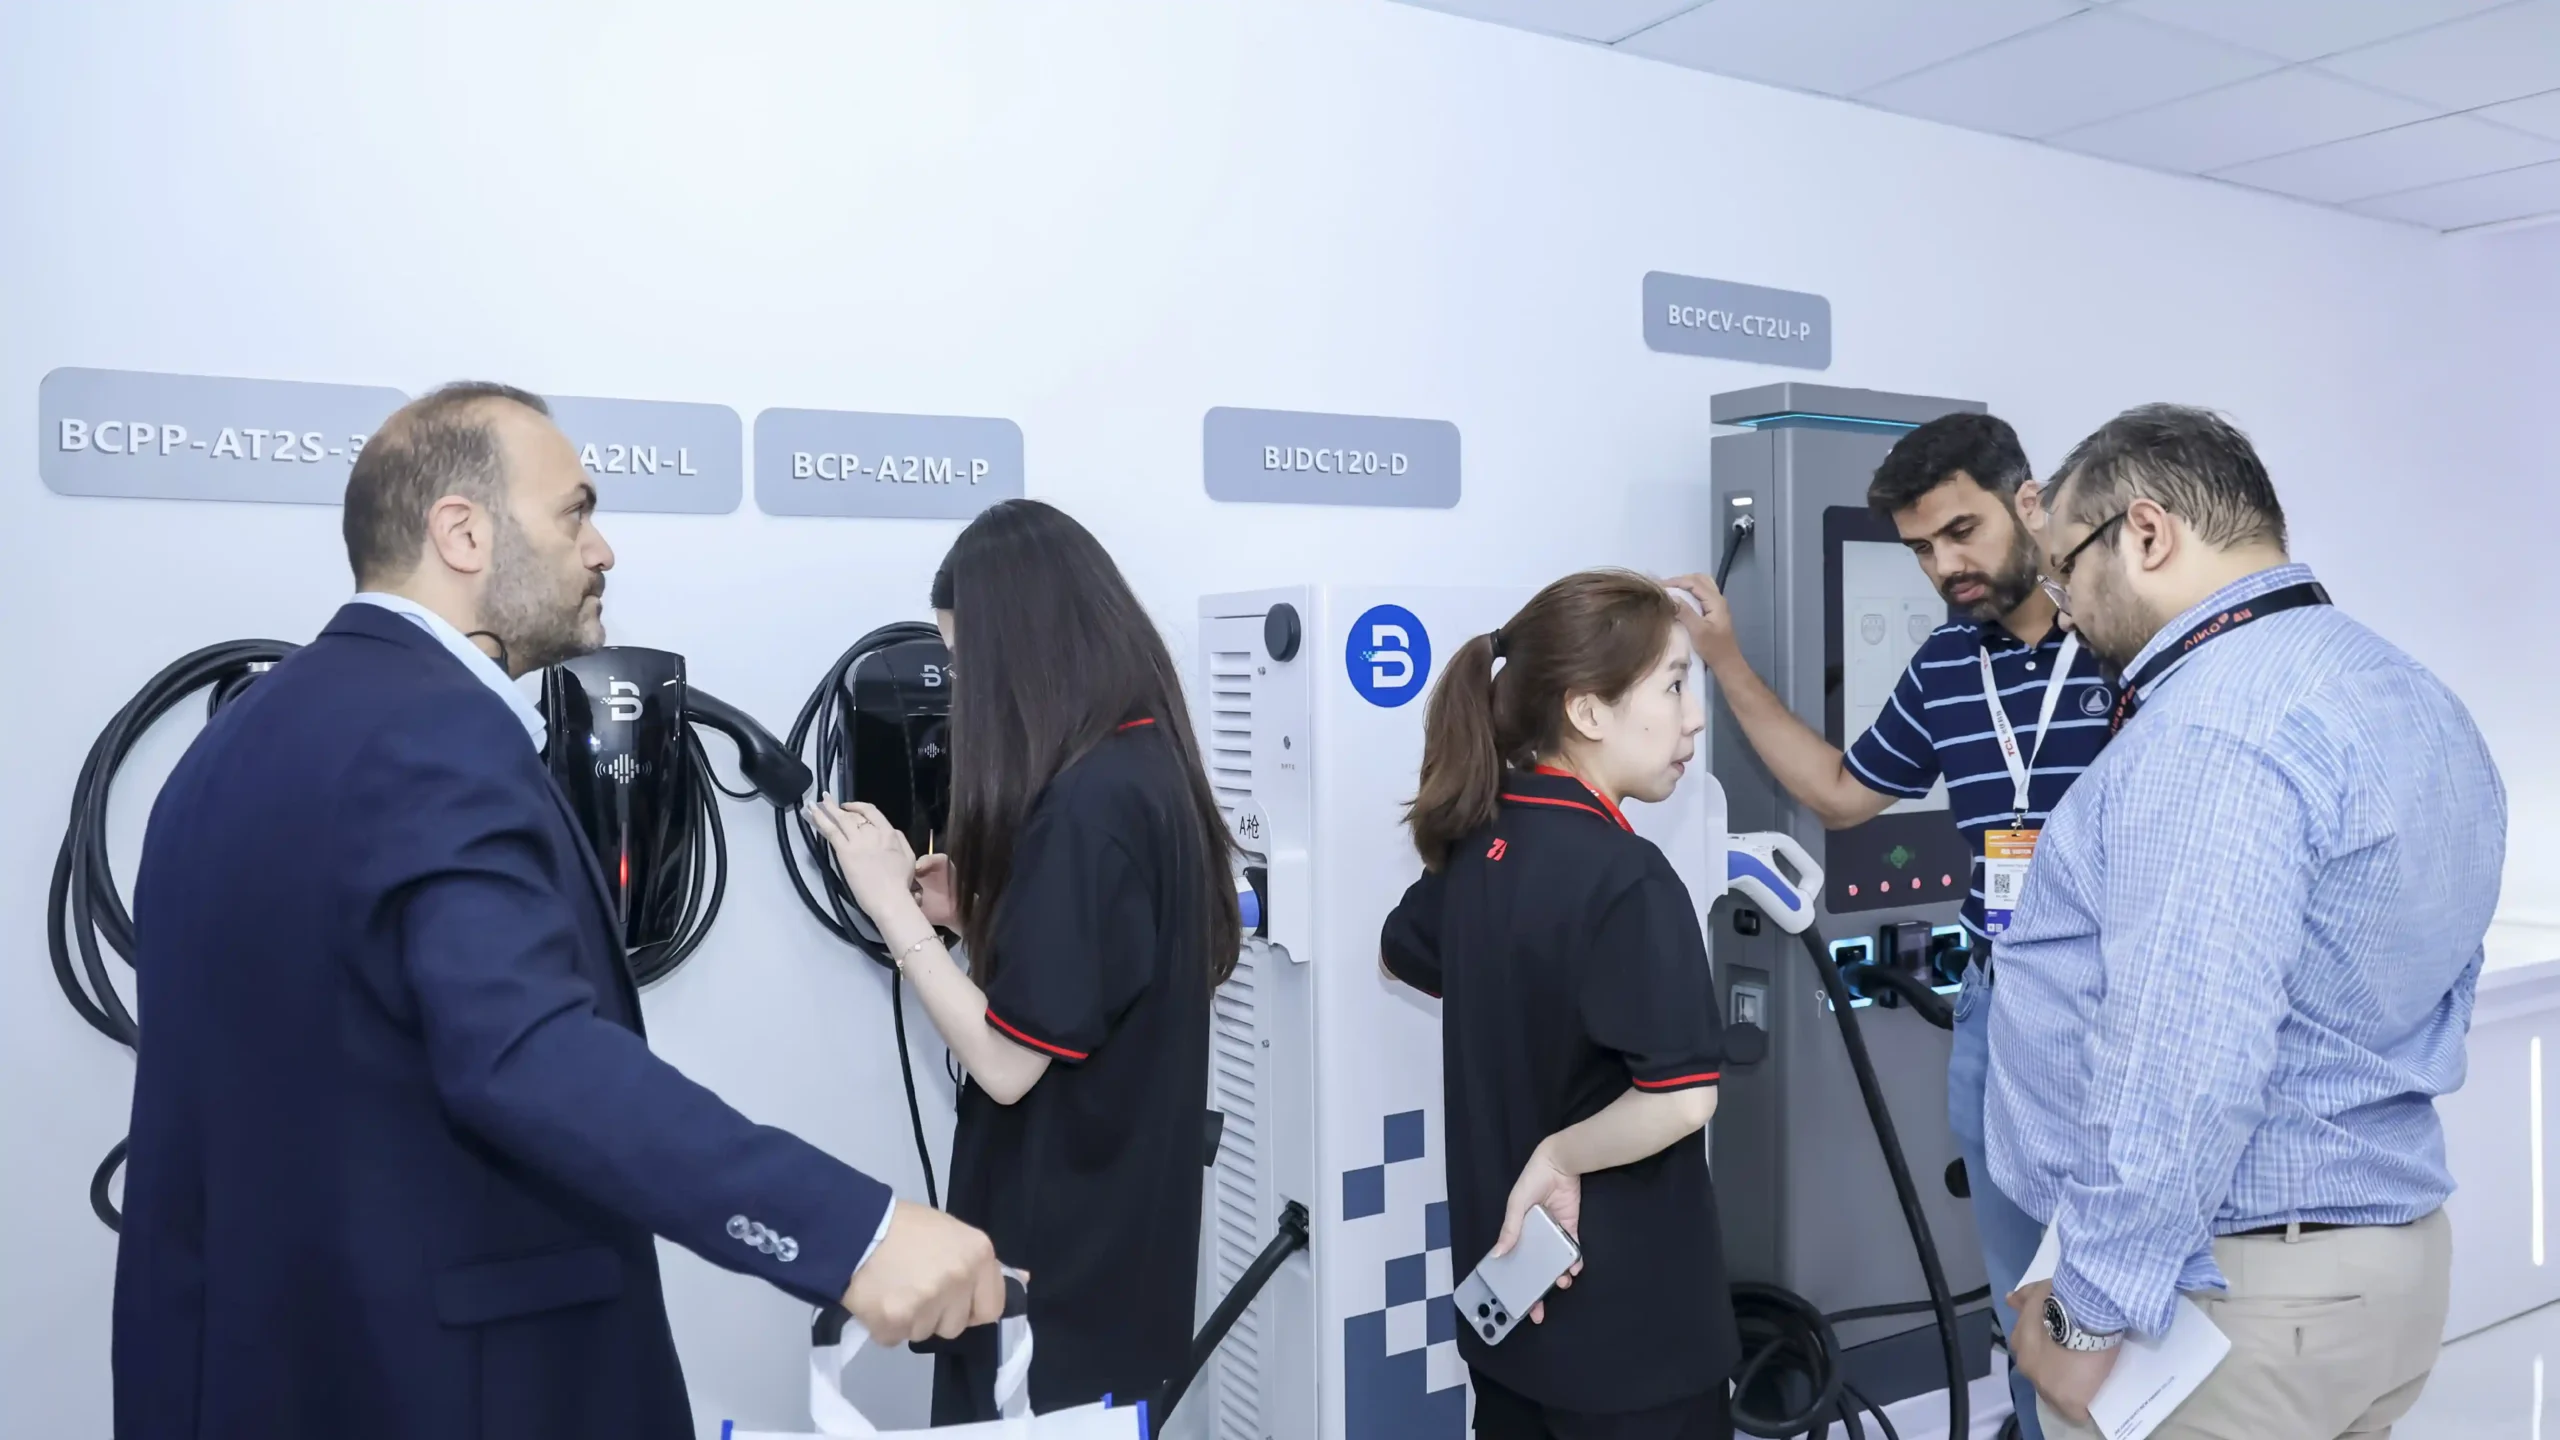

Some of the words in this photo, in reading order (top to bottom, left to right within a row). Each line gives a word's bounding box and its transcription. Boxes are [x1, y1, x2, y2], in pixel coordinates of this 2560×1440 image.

[1668, 303, 1811, 342] BCPCV-CT2U-P
[793, 451, 990, 485] BCP-A2M-P
[1264, 445, 1409, 476] BJDC120-D
